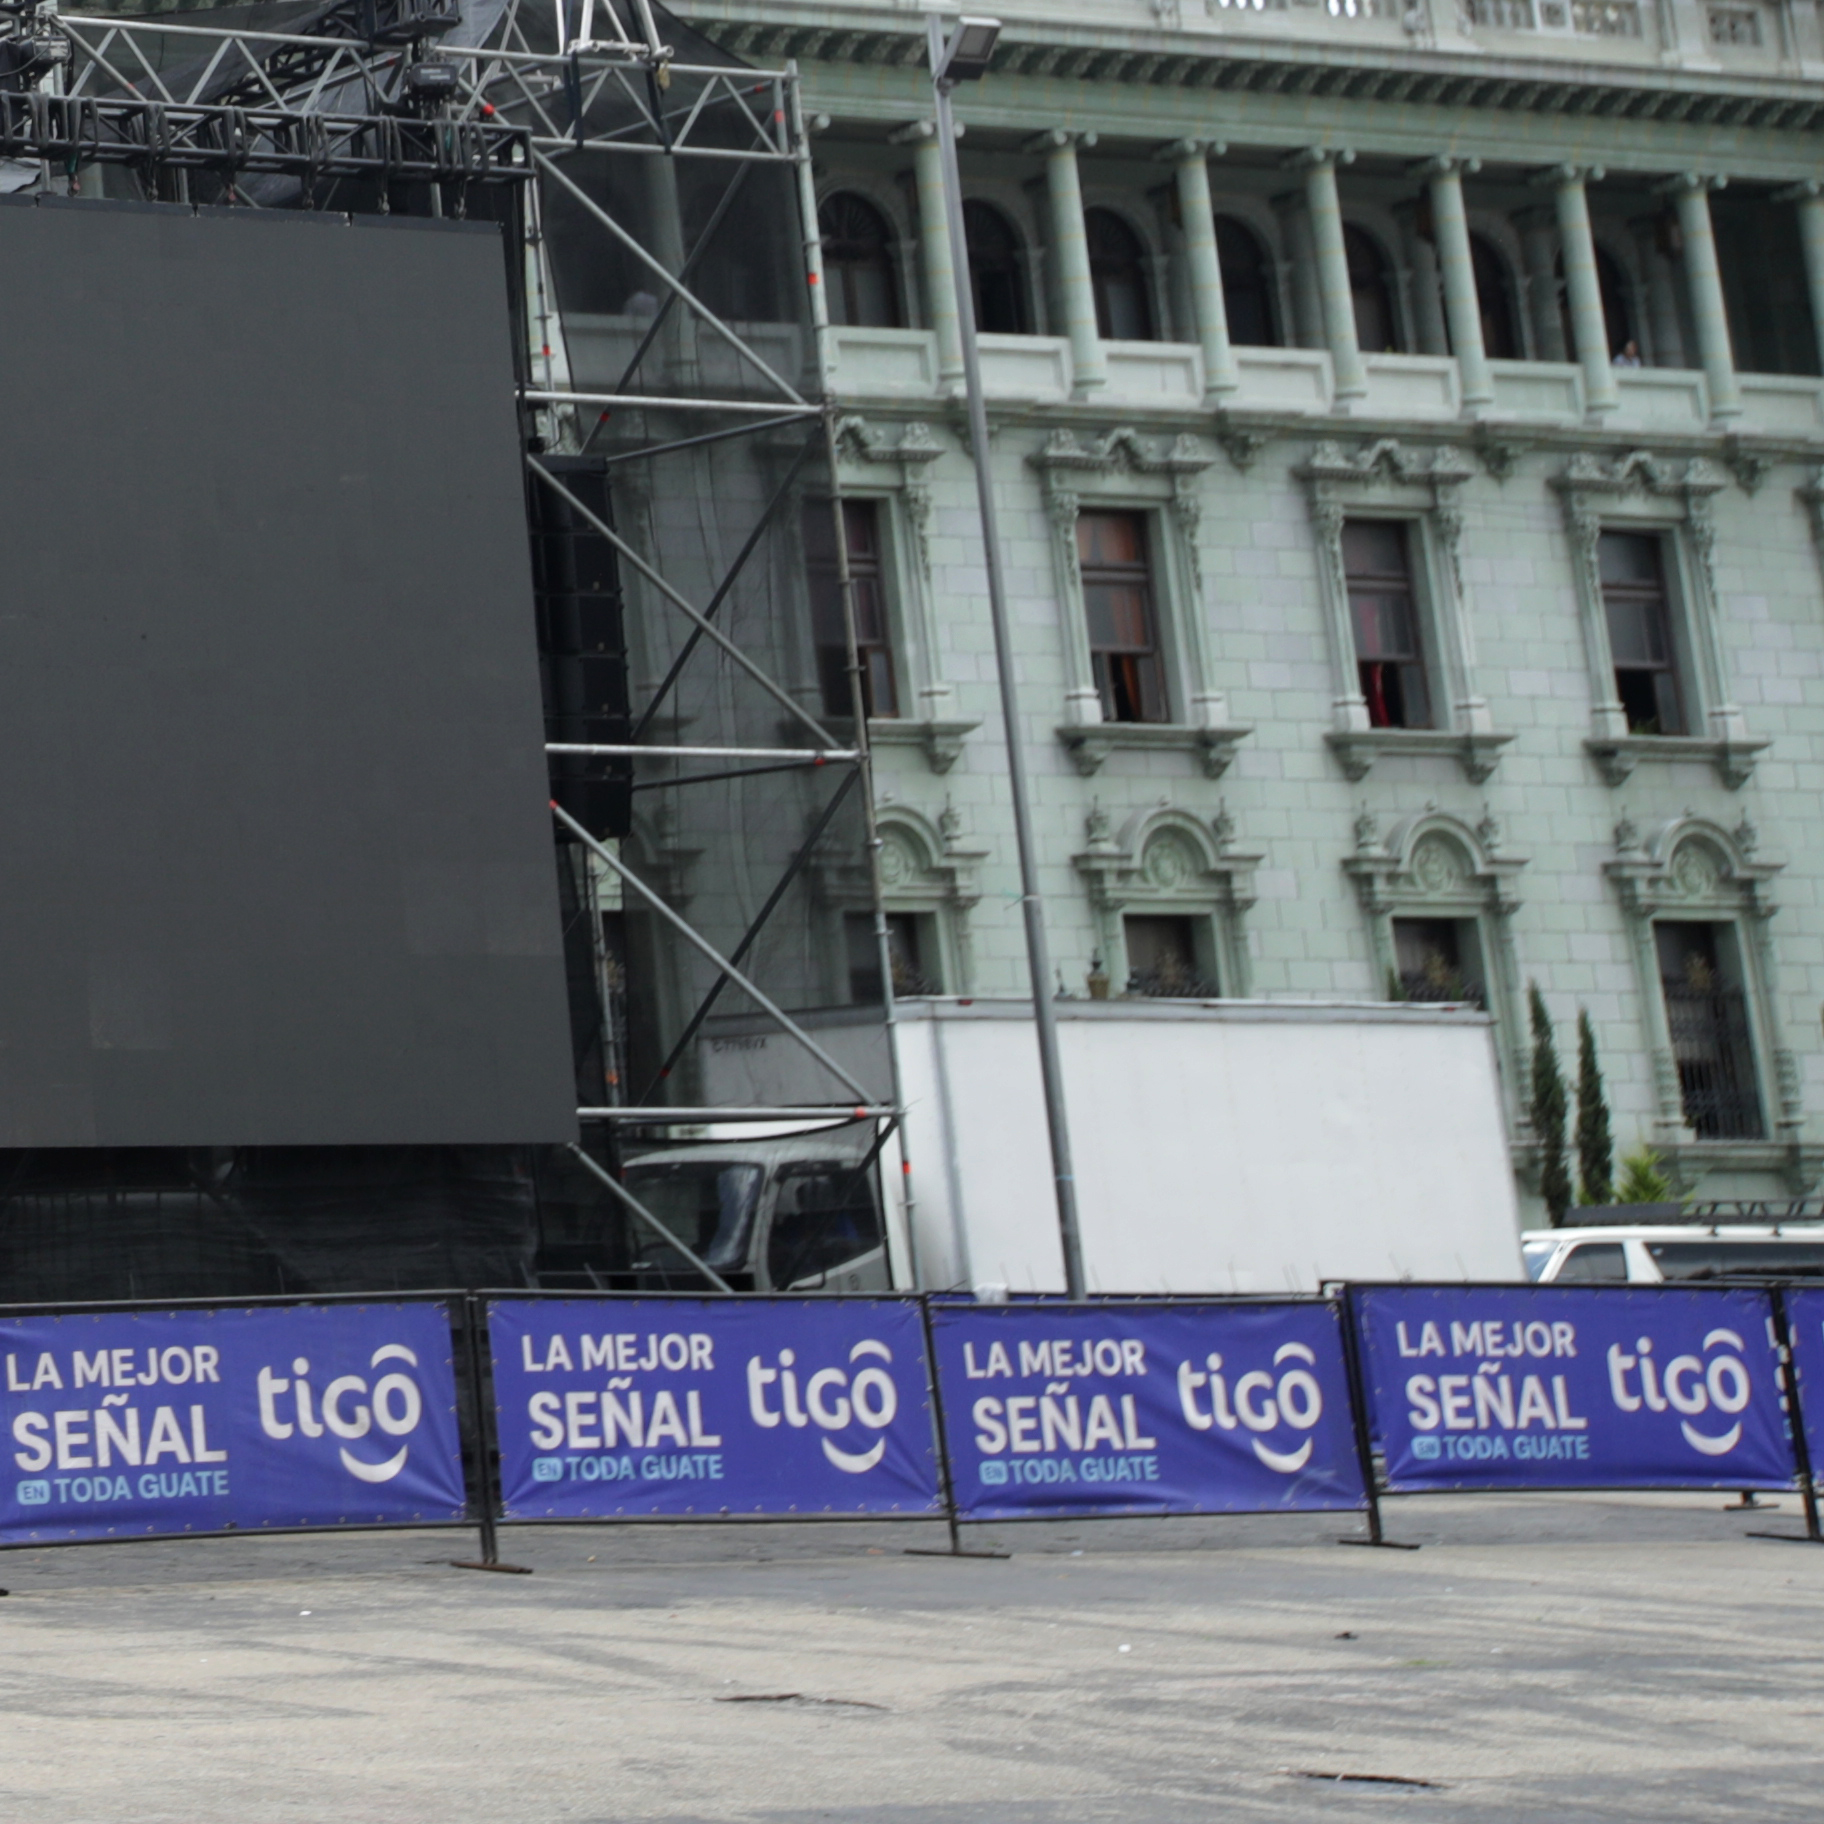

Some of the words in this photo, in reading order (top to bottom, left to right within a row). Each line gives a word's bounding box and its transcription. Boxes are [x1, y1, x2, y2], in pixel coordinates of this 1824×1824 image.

[522, 1334, 573, 1372] LA
[581, 1333, 714, 1371] MEJOR
[1396, 1321, 1445, 1357] LA
[1450, 1321, 1576, 1357] MEJOR
[7, 1352, 63, 1392] LA
[73, 1345, 220, 1388] MEJOR
[964, 1342, 1013, 1379] LA
[1019, 1339, 1147, 1378] MEJOR
[529, 1377, 721, 1450] SEÑAL
[1406, 1362, 1587, 1430] SEÑAL
[12, 1393, 228, 1472] SEÑAL
[973, 1382, 1157, 1454] SEÑAL
[1443, 1436, 1508, 1459] TODA
[1513, 1436, 1590, 1459] GUATE
[54, 1476, 133, 1504] TODA
[138, 1470, 230, 1498] GUATE
[565, 1456, 635, 1481] TODA
[642, 1455, 724, 1480] GUATE
[1009, 1459, 1077, 1484] TODA
[1080, 1456, 1159, 1482] GUATE
